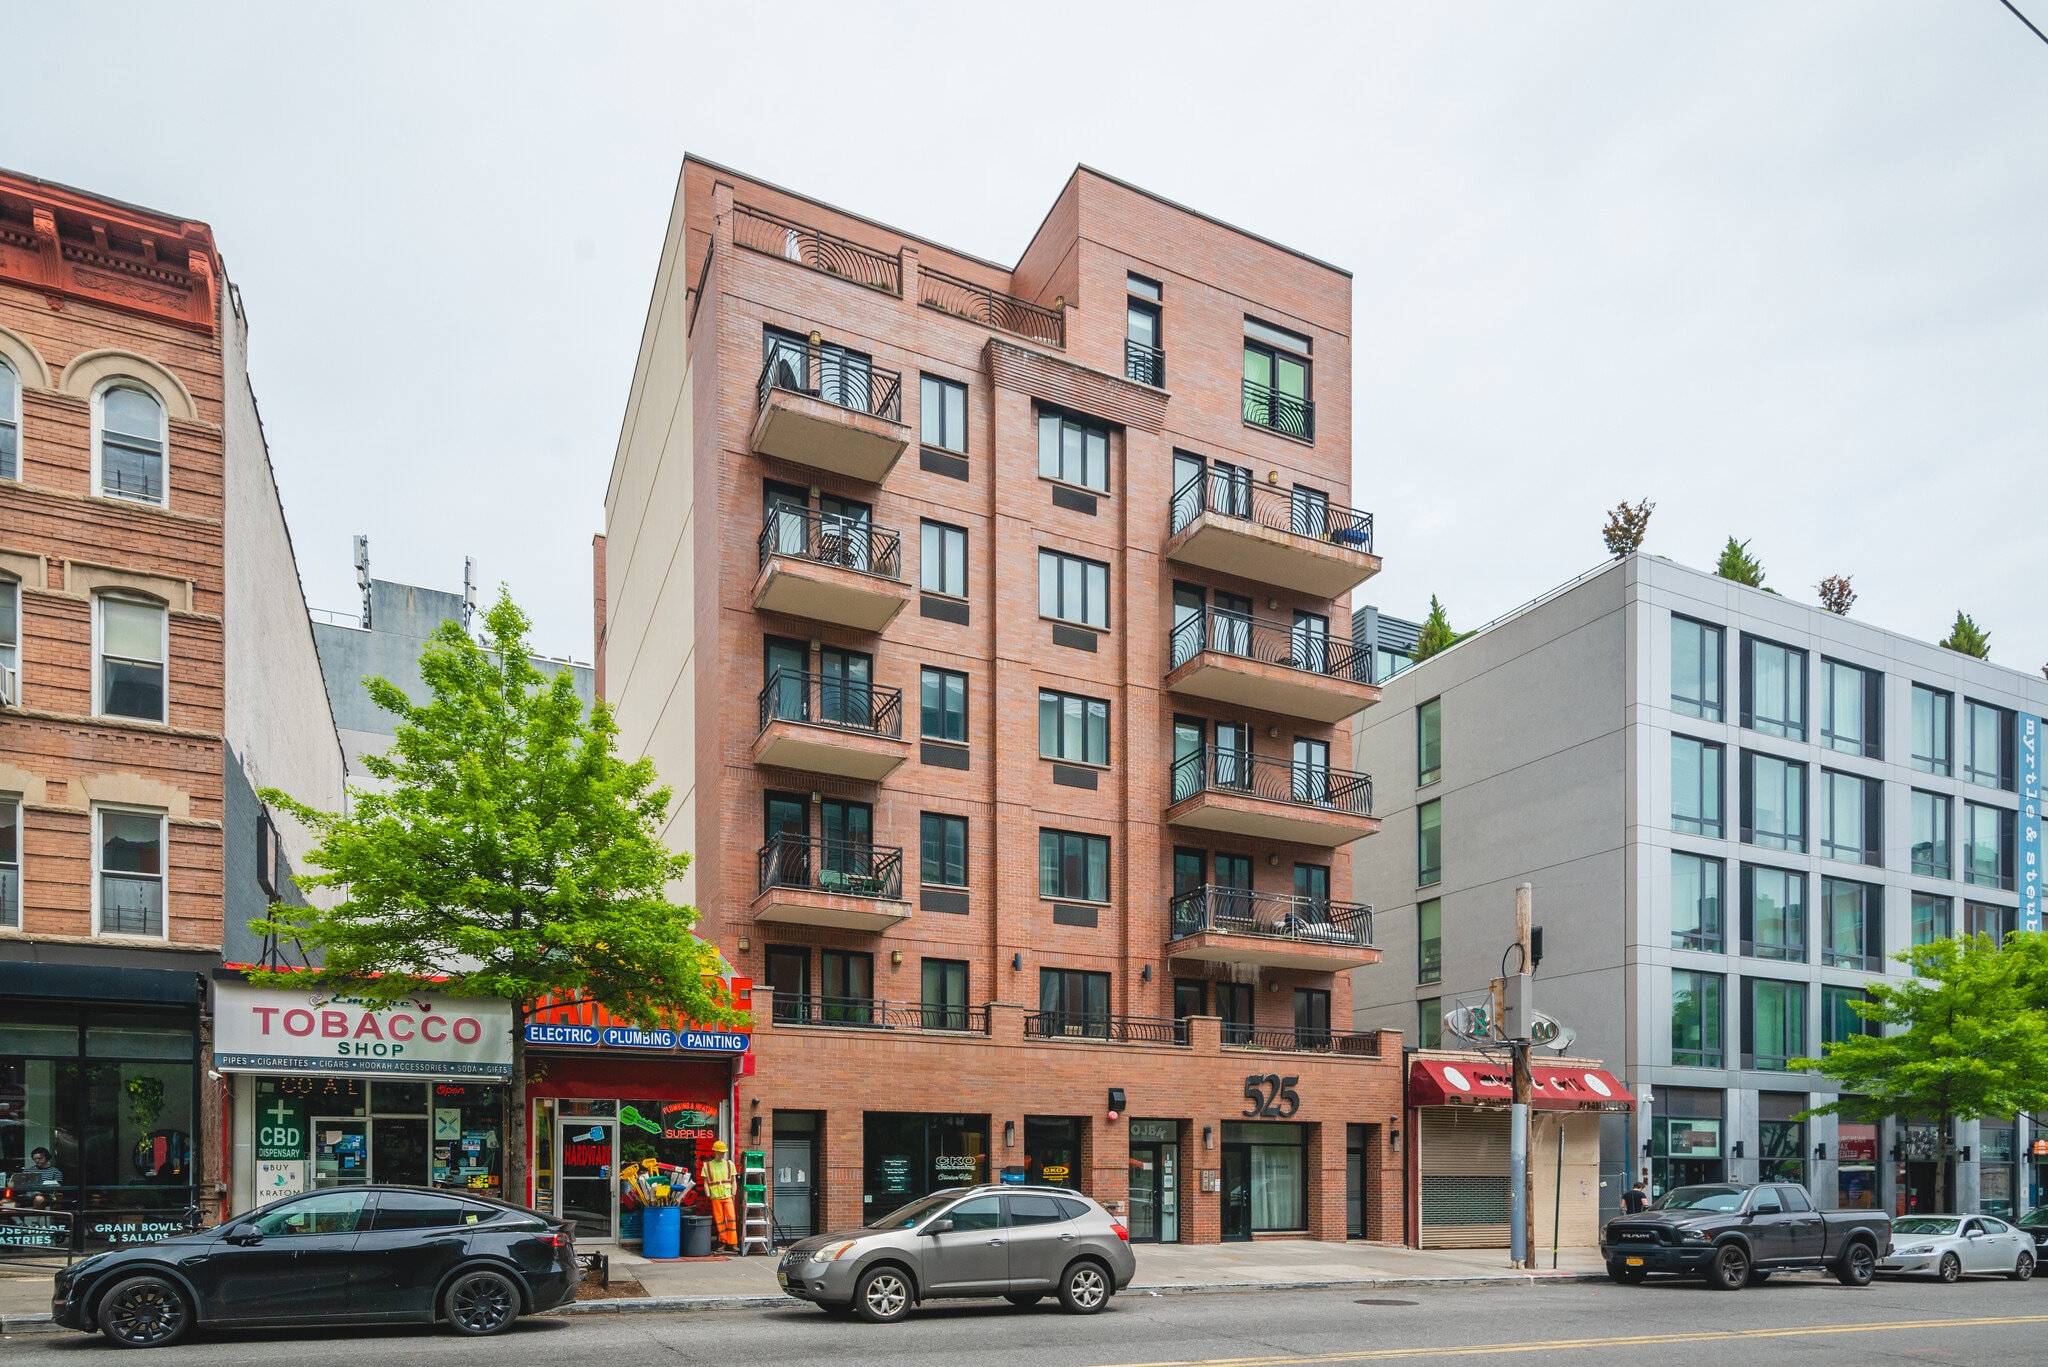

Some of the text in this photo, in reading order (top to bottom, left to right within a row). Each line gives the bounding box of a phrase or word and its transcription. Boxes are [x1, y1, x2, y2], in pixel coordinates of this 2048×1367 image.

[2023, 719, 2037, 818] myrtle
[2026, 827, 2037, 842] &
[252, 1006, 482, 1044] TOBACCO
[530, 1026, 592, 1043] ELECTRIC
[609, 1032, 671, 1047] PLUMBING
[337, 1041, 404, 1057] SHOP
[687, 1036, 741, 1050] PAINTING
[222, 1056, 508, 1075] PIPES CIGARETTES CIGARS HOOKAH ACCESSORIES SODA GIFTS
[1242, 1073, 1300, 1117] 525
[260, 1127, 300, 1146] CBD
[665, 1129, 714, 1139] SUPPLIES
[259, 1148, 300, 1158] DISPENSARY
[564, 1144, 612, 1166] HARDWARE
[935, 1156, 976, 1166] CKO
[95, 1222, 183, 1233] GRAIN BOWLS
[109, 1234, 116, 1243] &
